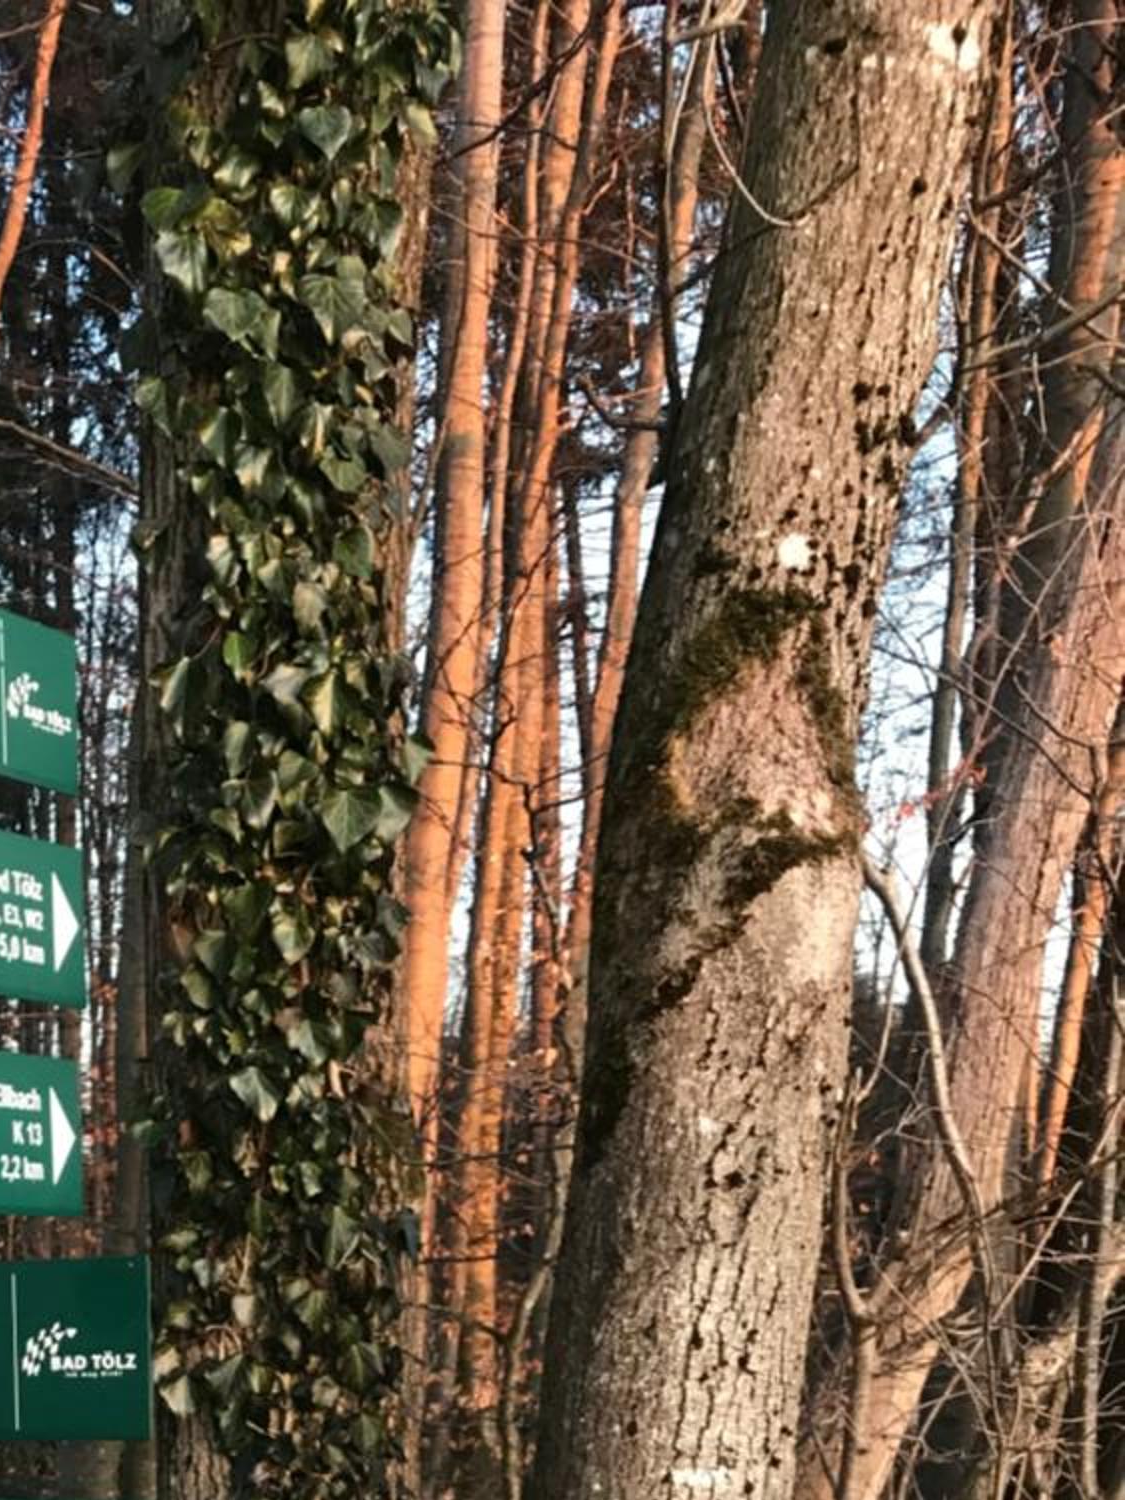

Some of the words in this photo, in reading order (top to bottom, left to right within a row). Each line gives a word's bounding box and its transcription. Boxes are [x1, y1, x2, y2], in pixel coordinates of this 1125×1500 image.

[10, 869, 44, 902] Tölz
[22, 937, 46, 966] km
[11, 1119, 25, 1145] K
[26, 1121, 44, 1146] 13
[0, 1153, 21, 1183] 2,2
[22, 1155, 45, 1181] km
[50, 1354, 87, 1372] BAD
[90, 1350, 138, 1371] TÖLZ
